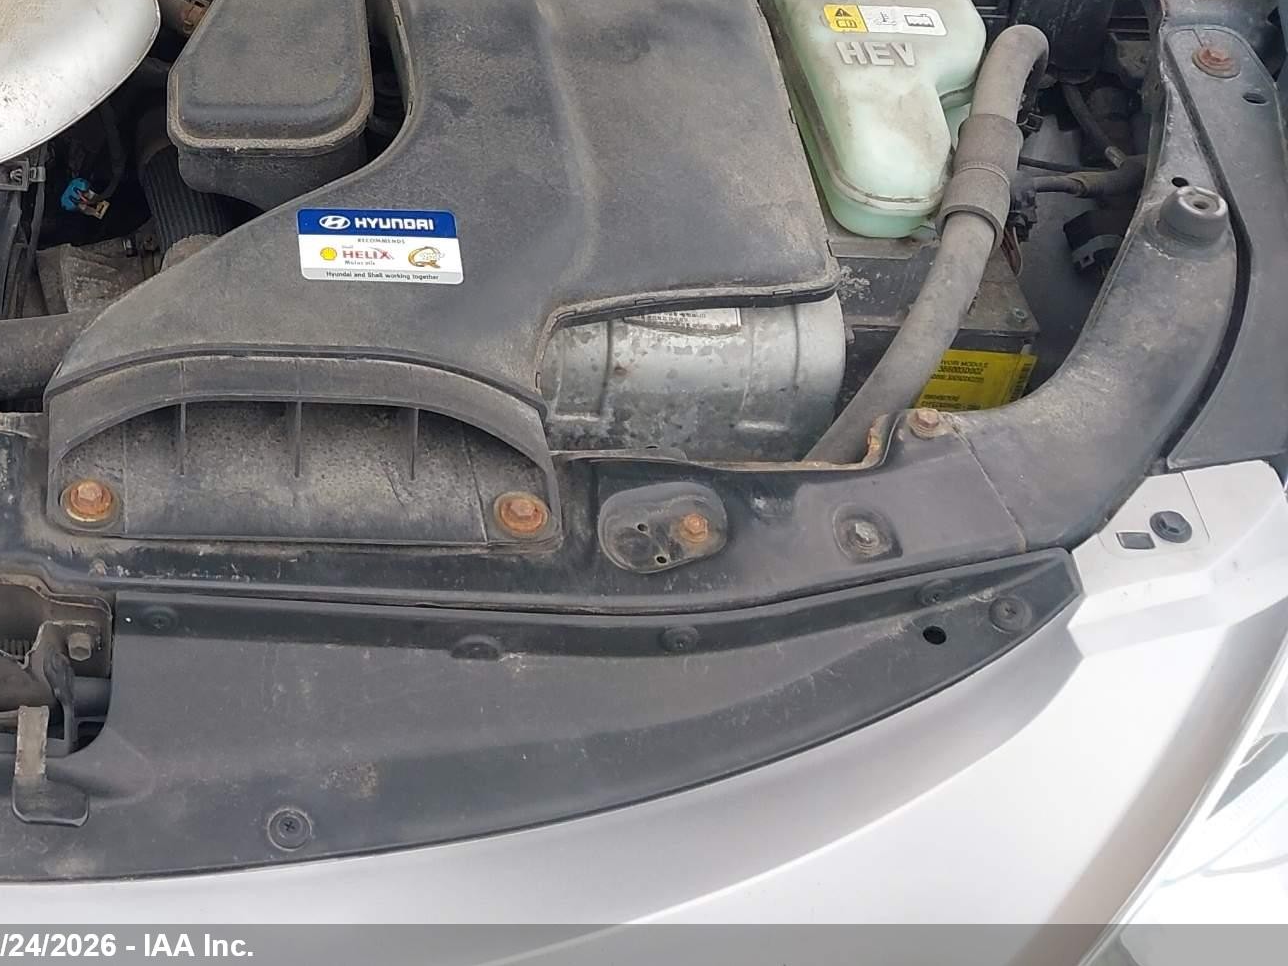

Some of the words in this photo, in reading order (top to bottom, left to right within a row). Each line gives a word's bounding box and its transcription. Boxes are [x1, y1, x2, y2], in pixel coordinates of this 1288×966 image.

[835, 41, 916, 66] HEV
[354, 217, 435, 231] HYUNDAI
[342, 248, 393, 260] HELIX
[326, 271, 352, 279] Hyundai
[412, 273, 439, 281] together
